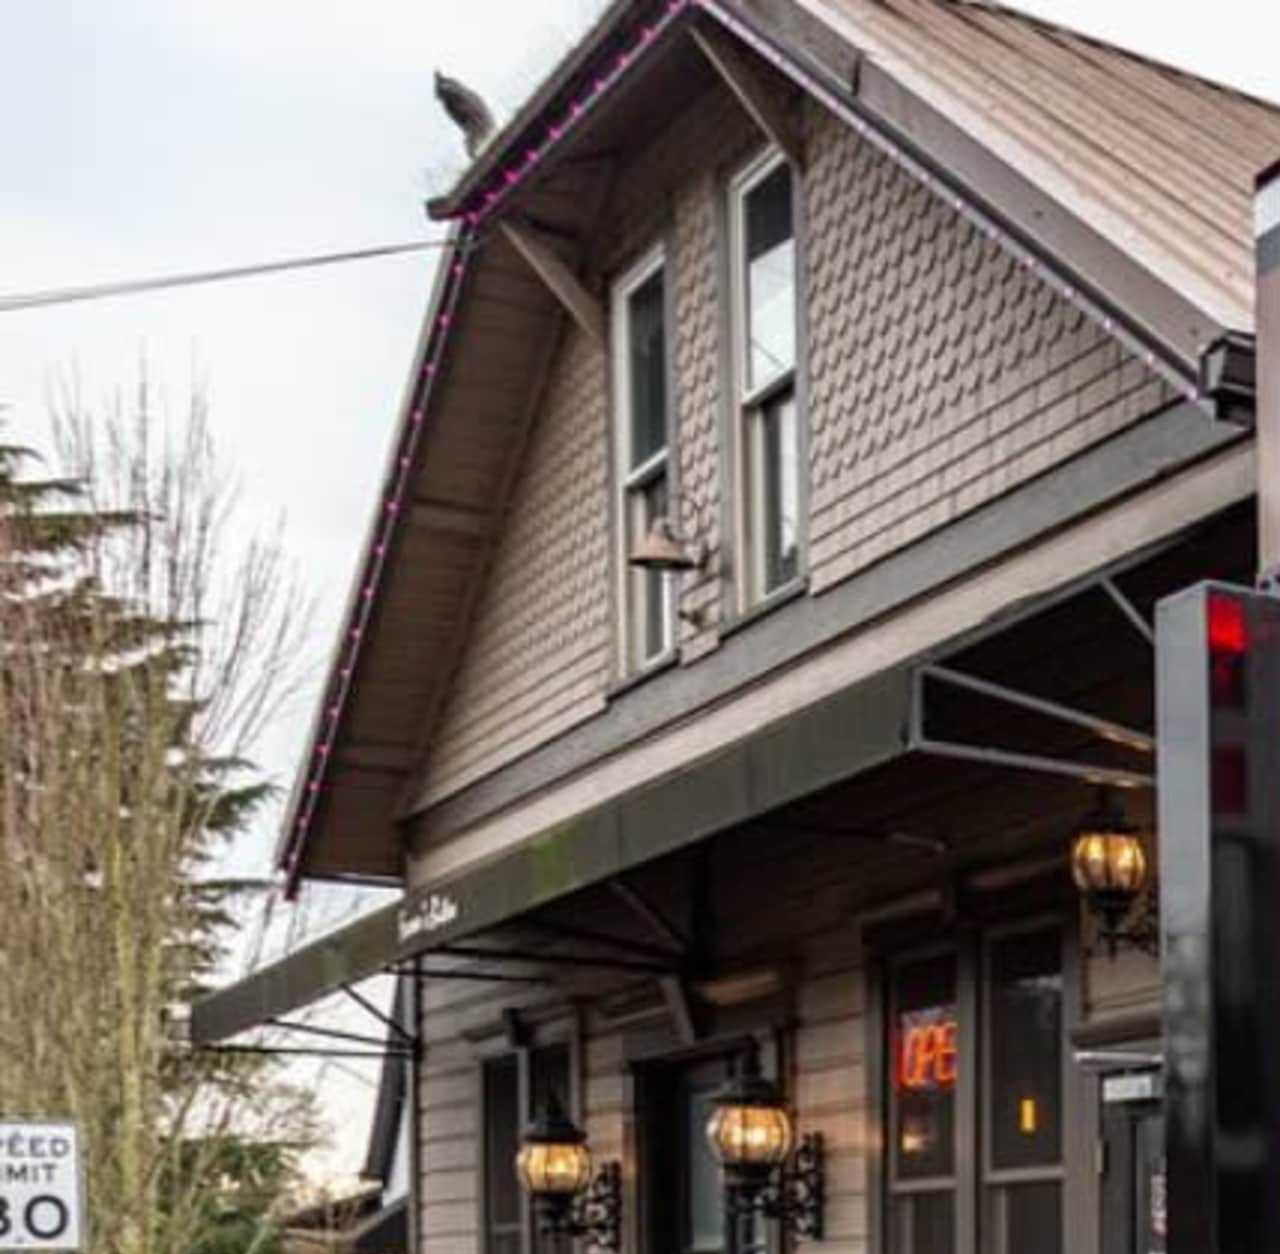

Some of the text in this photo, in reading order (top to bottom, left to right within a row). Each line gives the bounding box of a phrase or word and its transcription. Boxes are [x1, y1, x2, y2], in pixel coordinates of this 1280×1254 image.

[900, 1020, 957, 1087] OPE
[0, 1134, 70, 1158] EED
[0, 1163, 57, 1182] MIT
